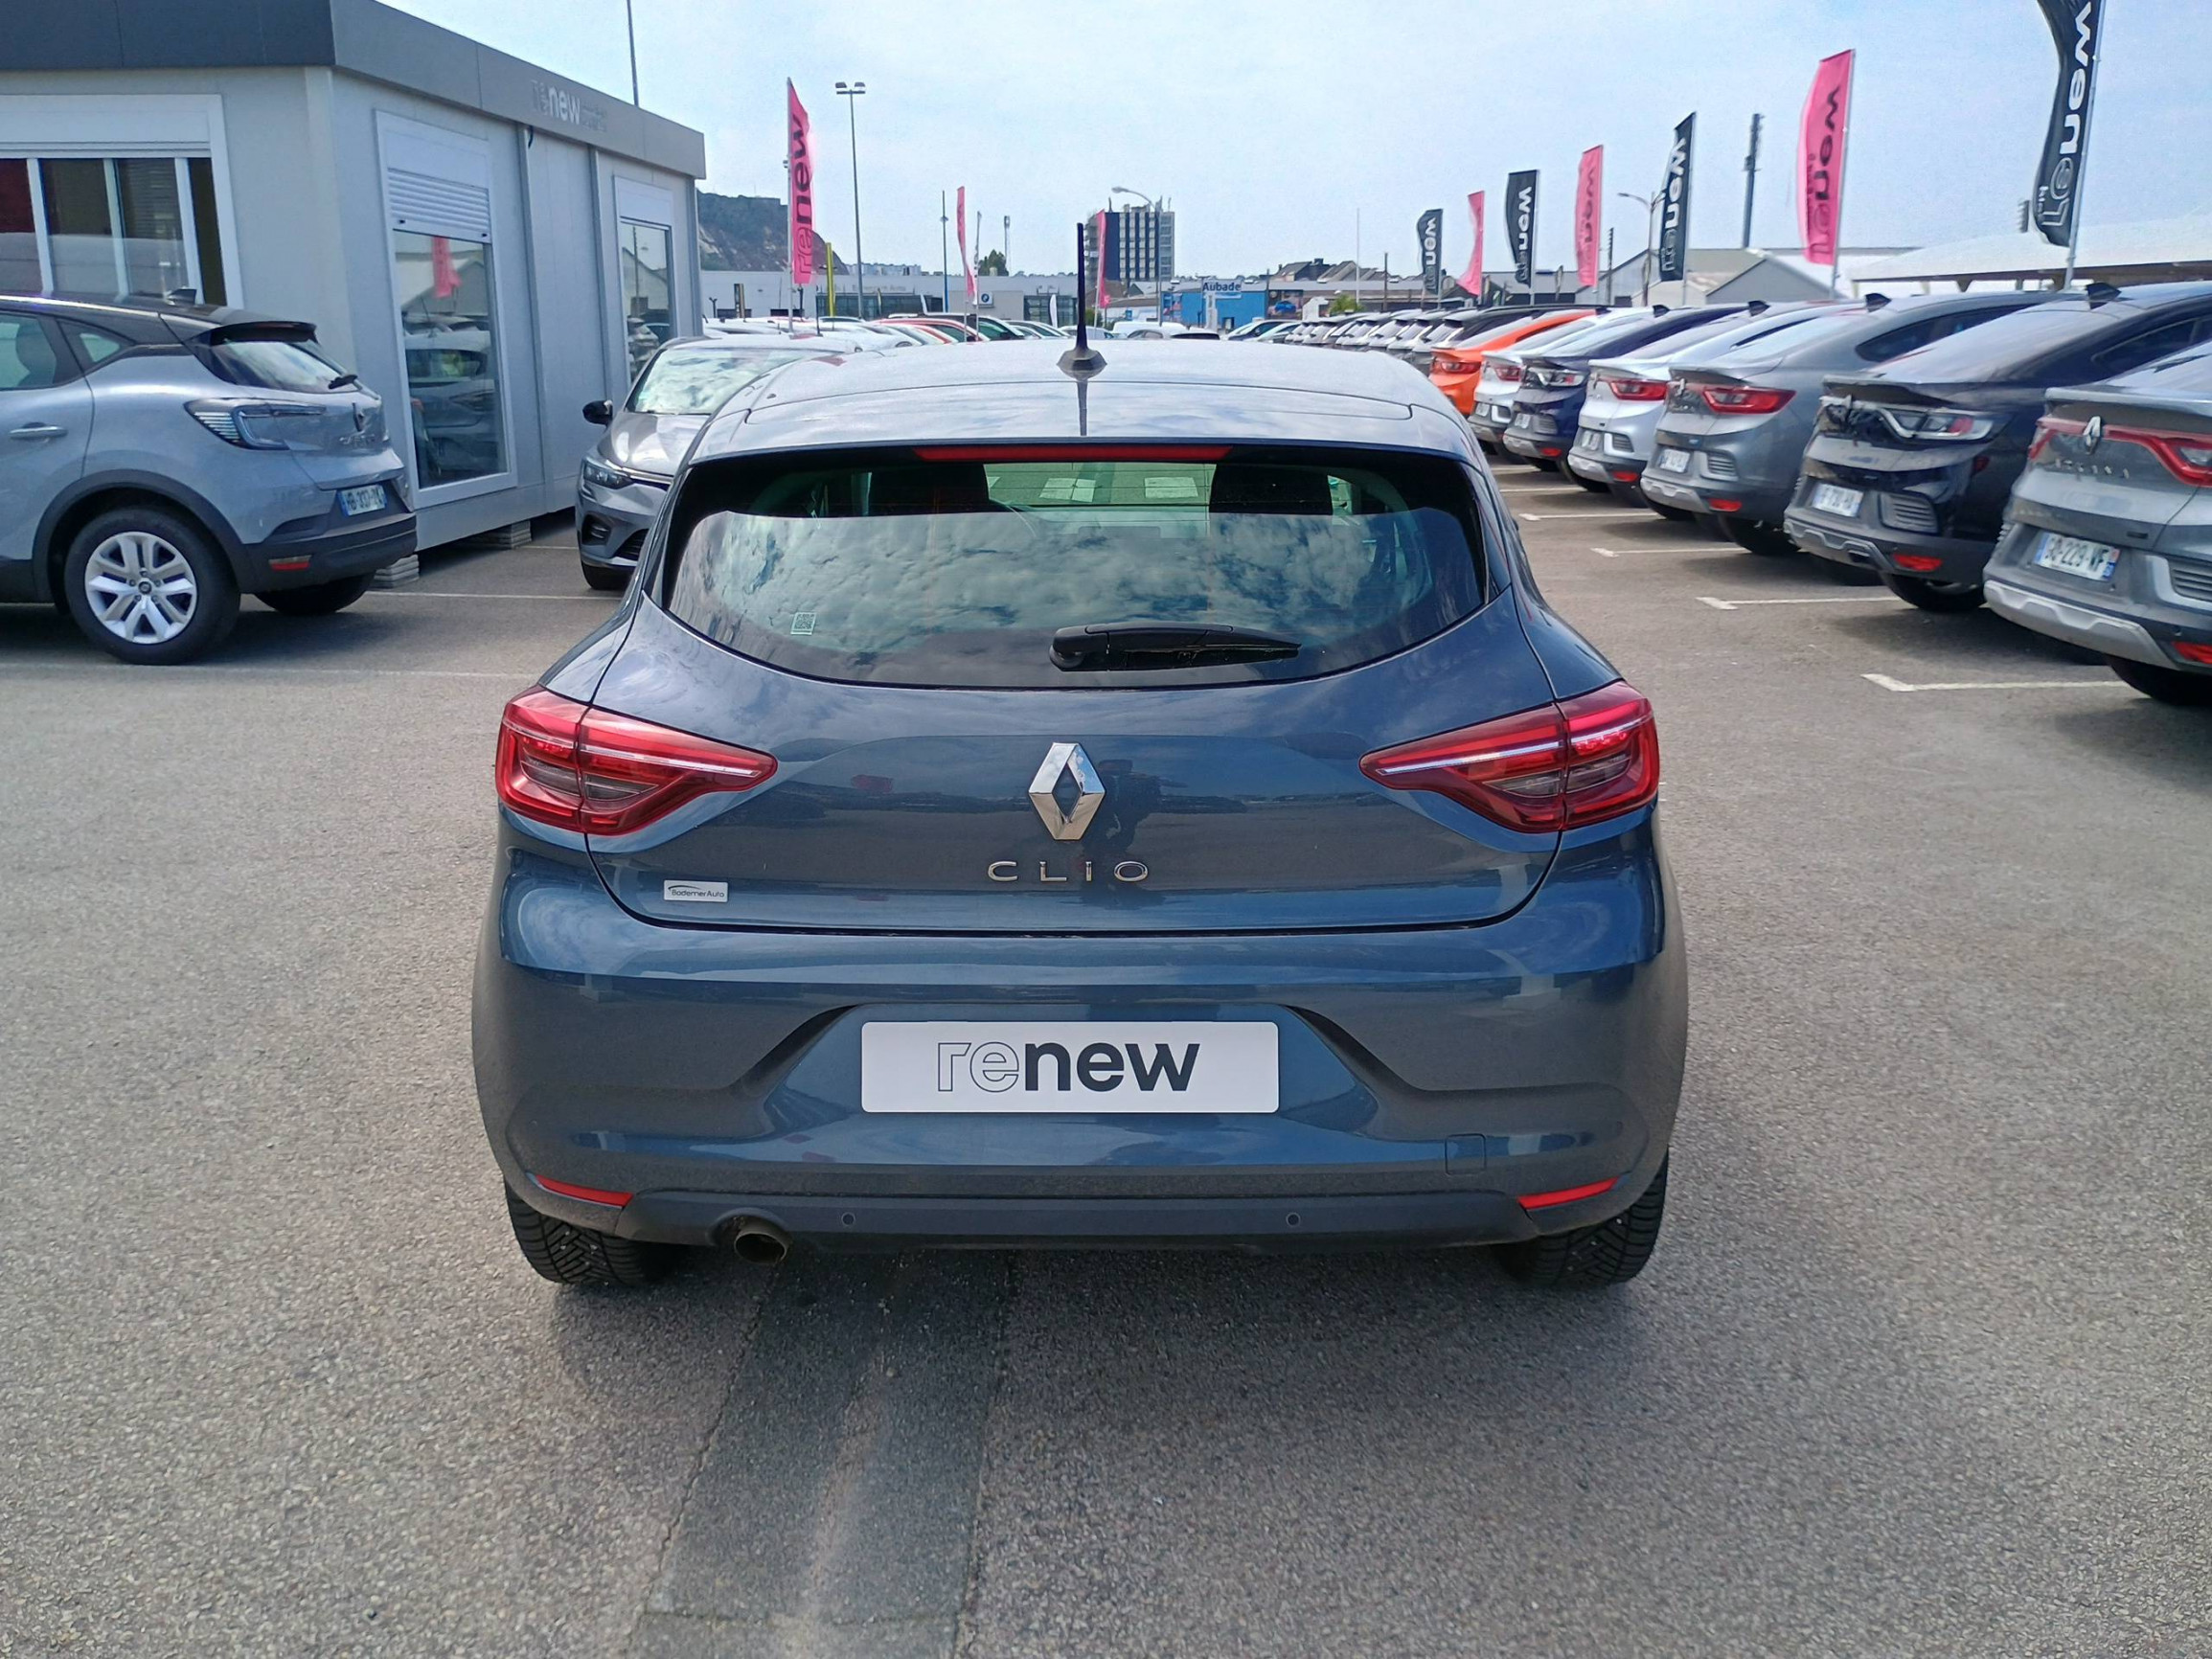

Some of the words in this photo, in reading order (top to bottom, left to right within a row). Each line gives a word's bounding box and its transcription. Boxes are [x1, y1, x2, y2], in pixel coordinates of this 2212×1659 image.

[792, 113, 812, 275] renew
[1202, 282, 1242, 291] Aubade
[988, 860, 1150, 882] CLIO
[937, 1041, 1201, 1093] renew
